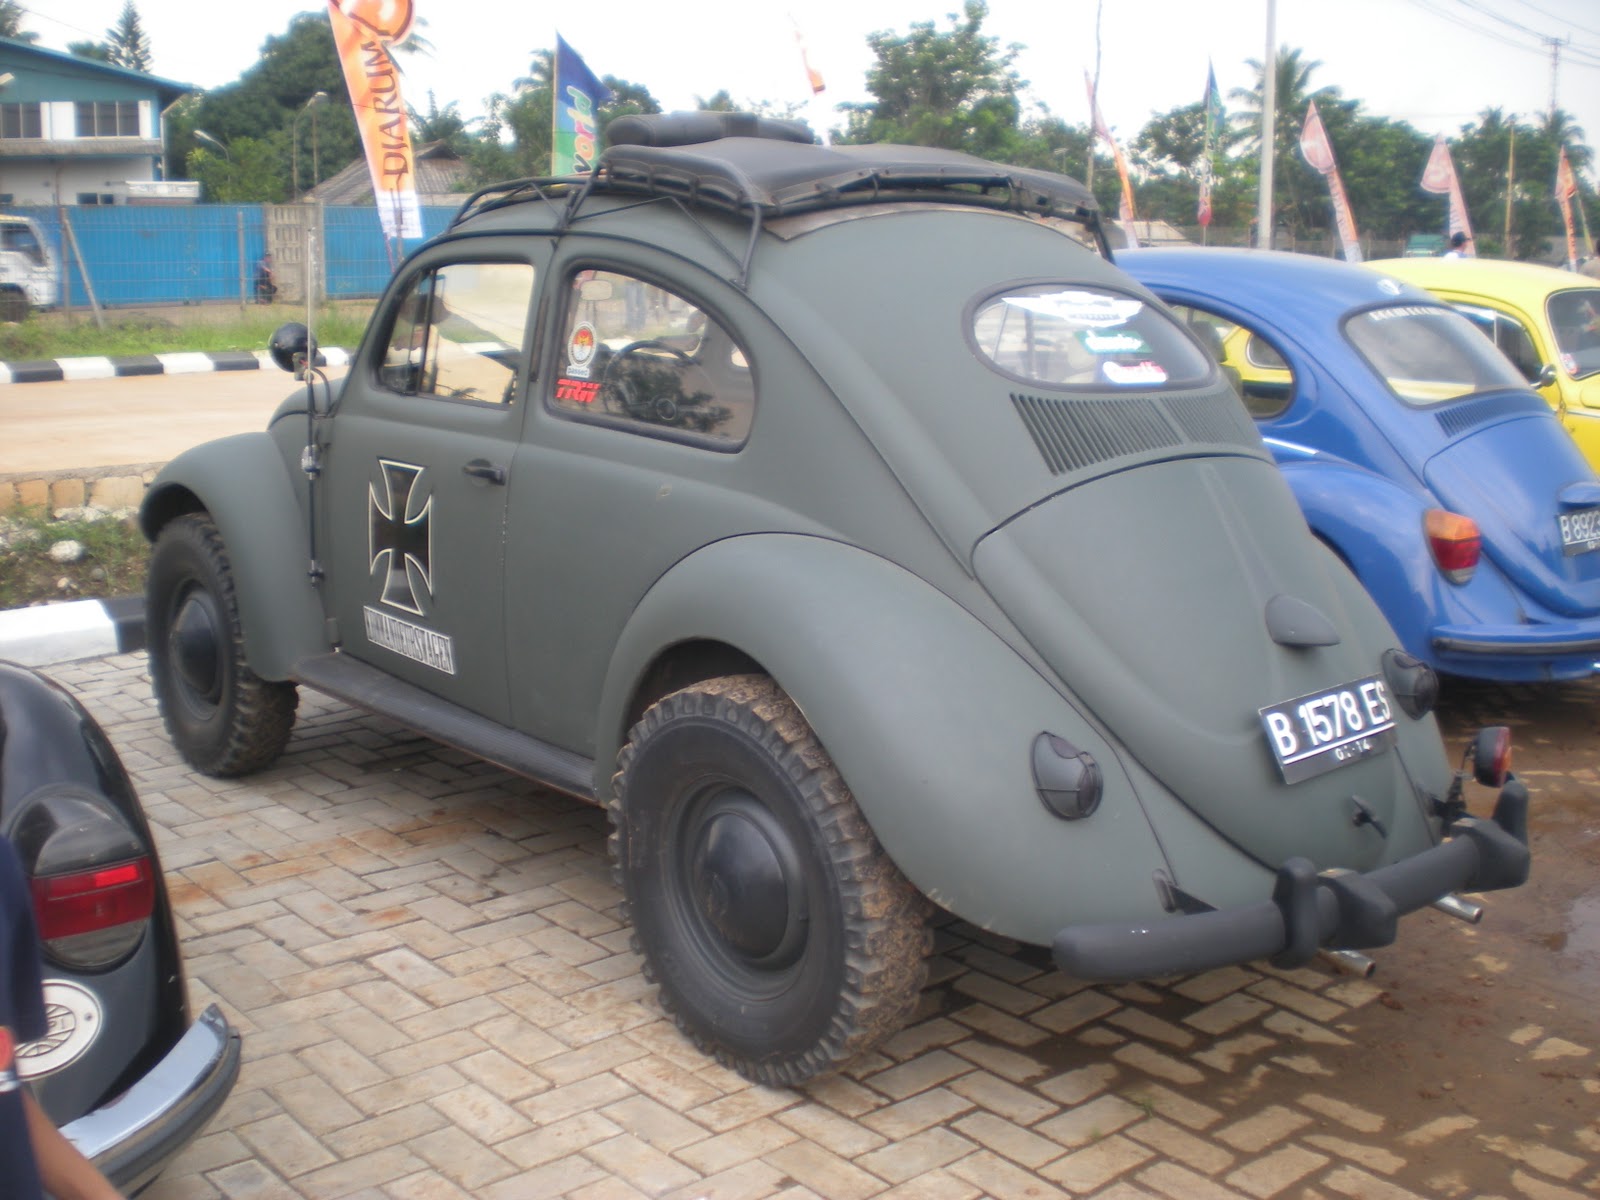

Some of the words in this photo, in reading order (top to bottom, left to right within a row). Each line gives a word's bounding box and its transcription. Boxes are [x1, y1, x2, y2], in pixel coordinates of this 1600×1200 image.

[556, 378, 601, 403] TRW
[1560, 514, 1571, 543] B
[1266, 712, 1298, 757] B
[1298, 691, 1363, 746] 1578
[1360, 681, 1392, 725] ES
